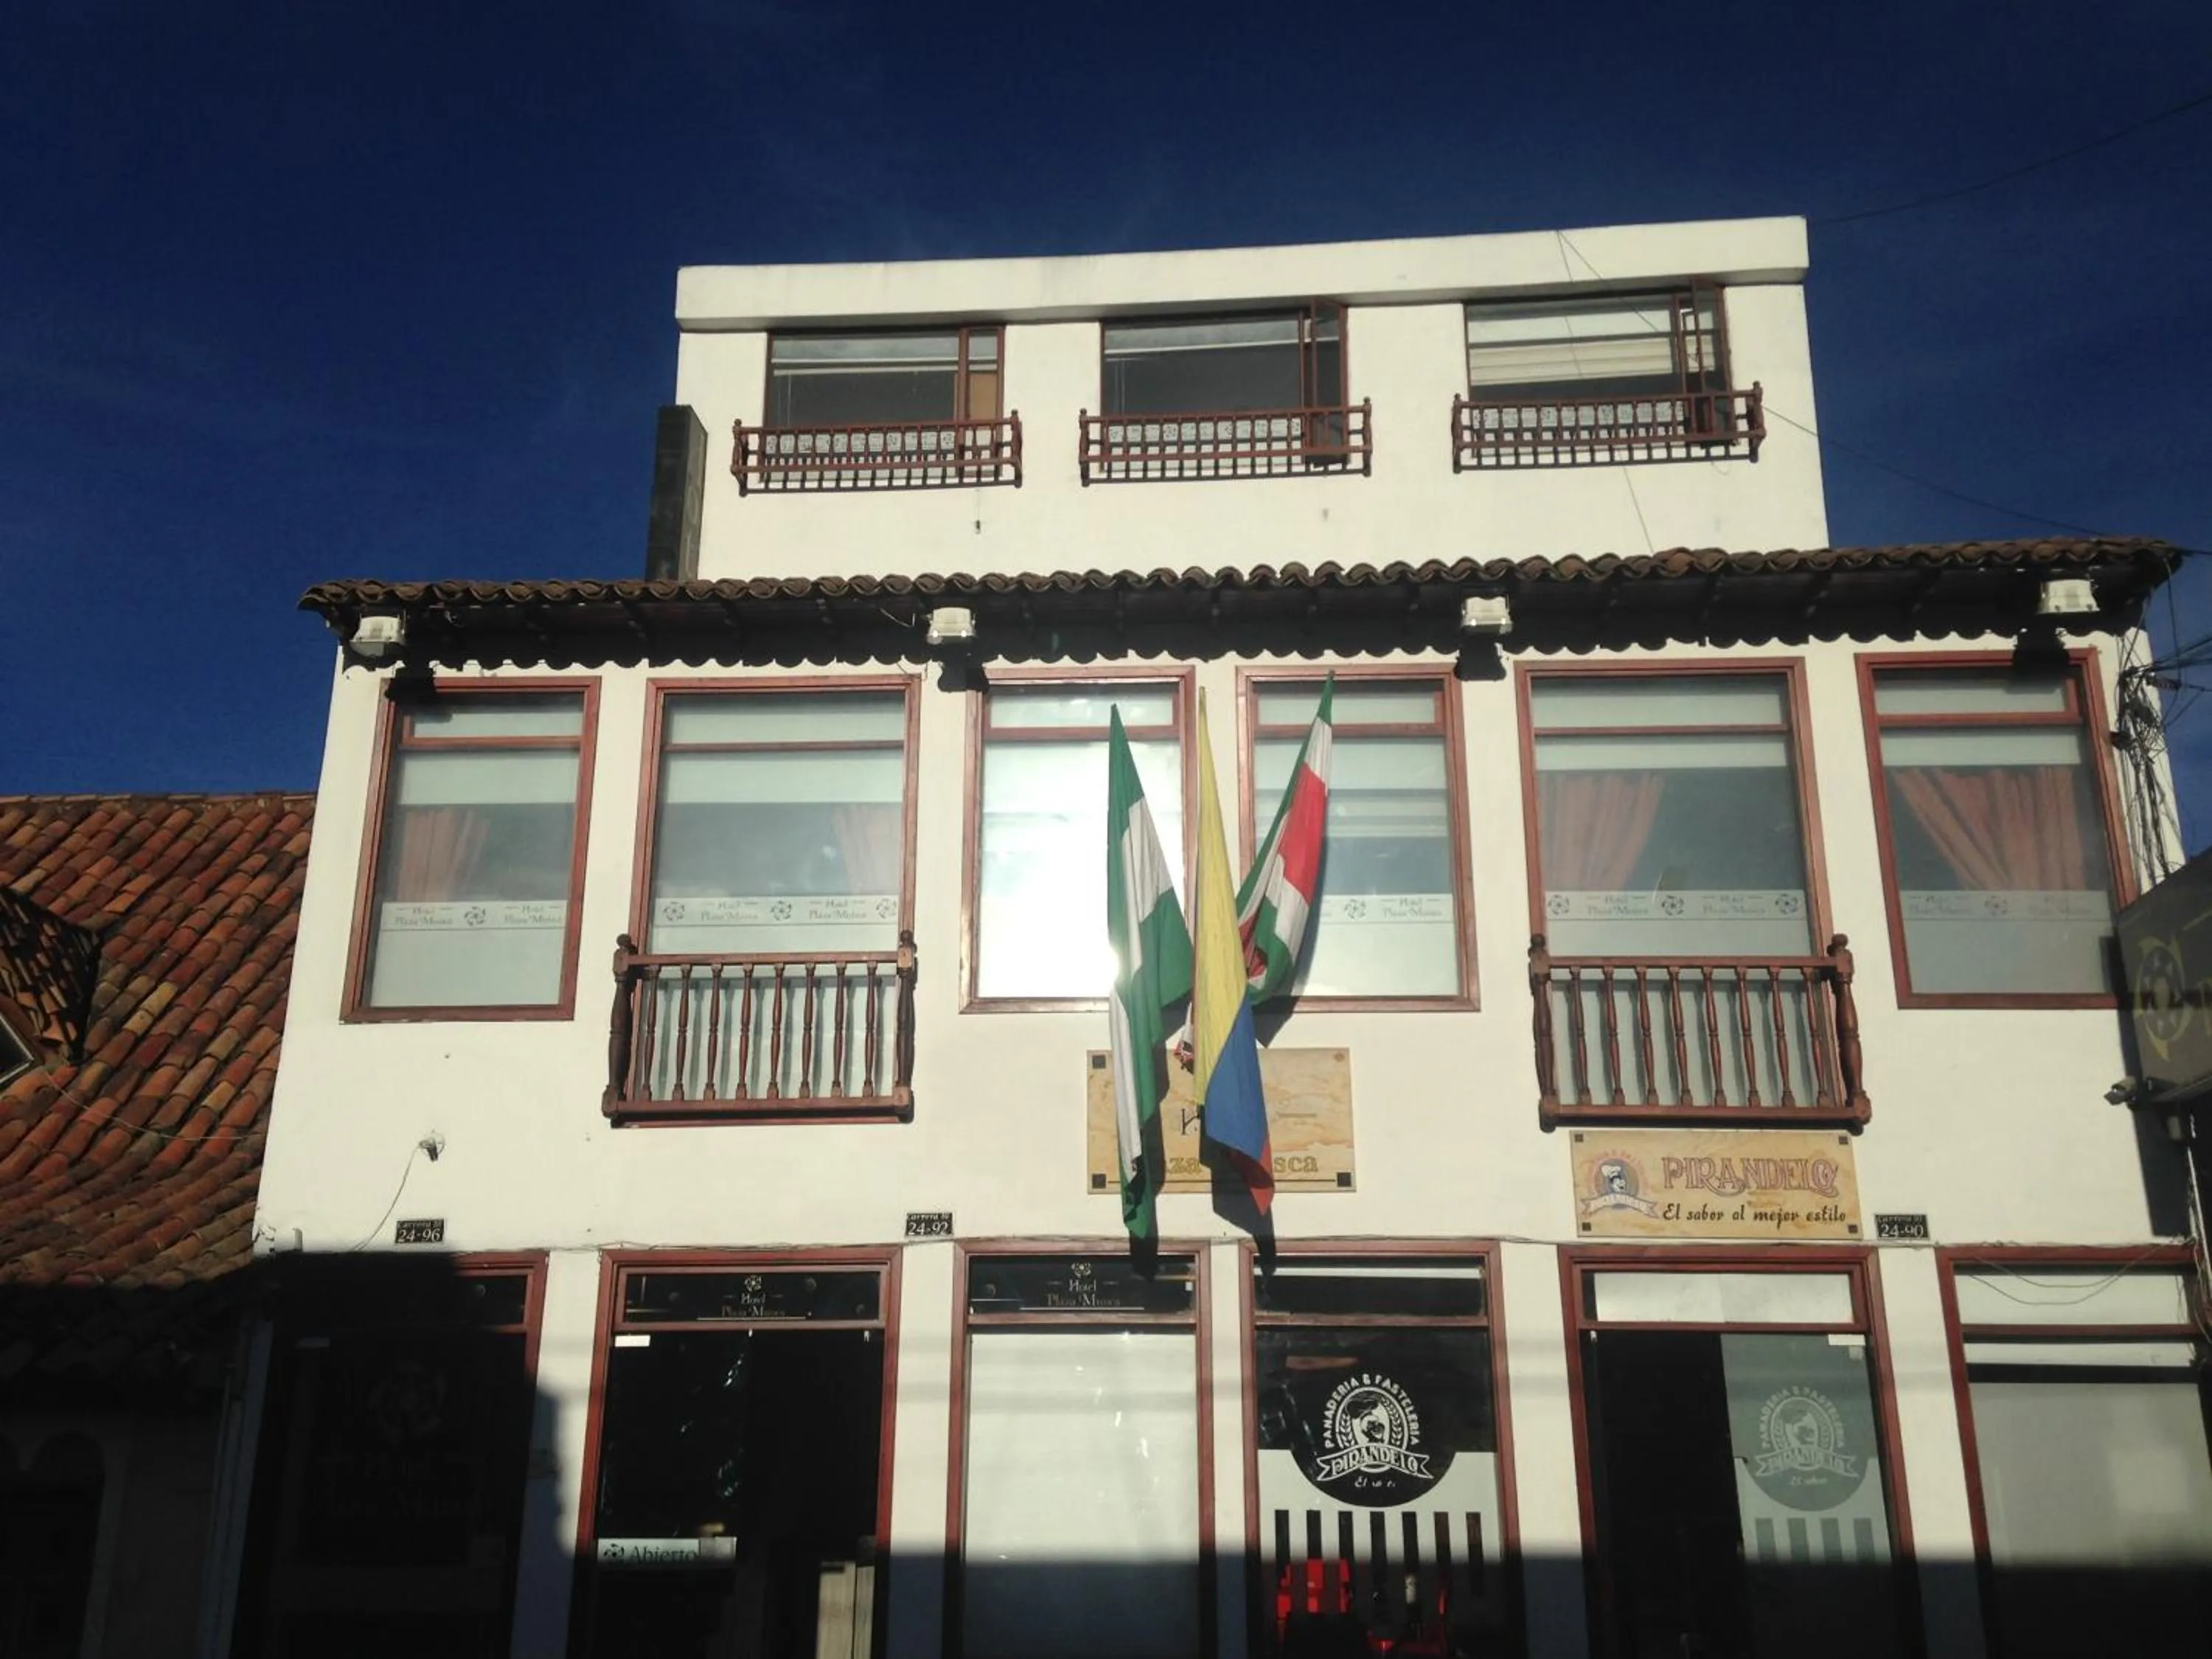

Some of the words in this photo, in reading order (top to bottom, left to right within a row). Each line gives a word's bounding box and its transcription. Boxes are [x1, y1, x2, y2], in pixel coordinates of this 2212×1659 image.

[1663, 1203, 1680, 1221] El
[1686, 1203, 1725, 1222] sabor
[1732, 1204, 1745, 1222] al
[1753, 1203, 1800, 1230] mejor
[1806, 1205, 1846, 1222] estilo
[397, 1228, 441, 1243] 24-96
[908, 1221, 948, 1236] 24-92
[1880, 1223, 1924, 1237] 24-90
[1069, 1279, 1096, 1292] Hotel
[1323, 1377, 1360, 1449] PANADERIA
[631, 1545, 698, 1563] Abierto
